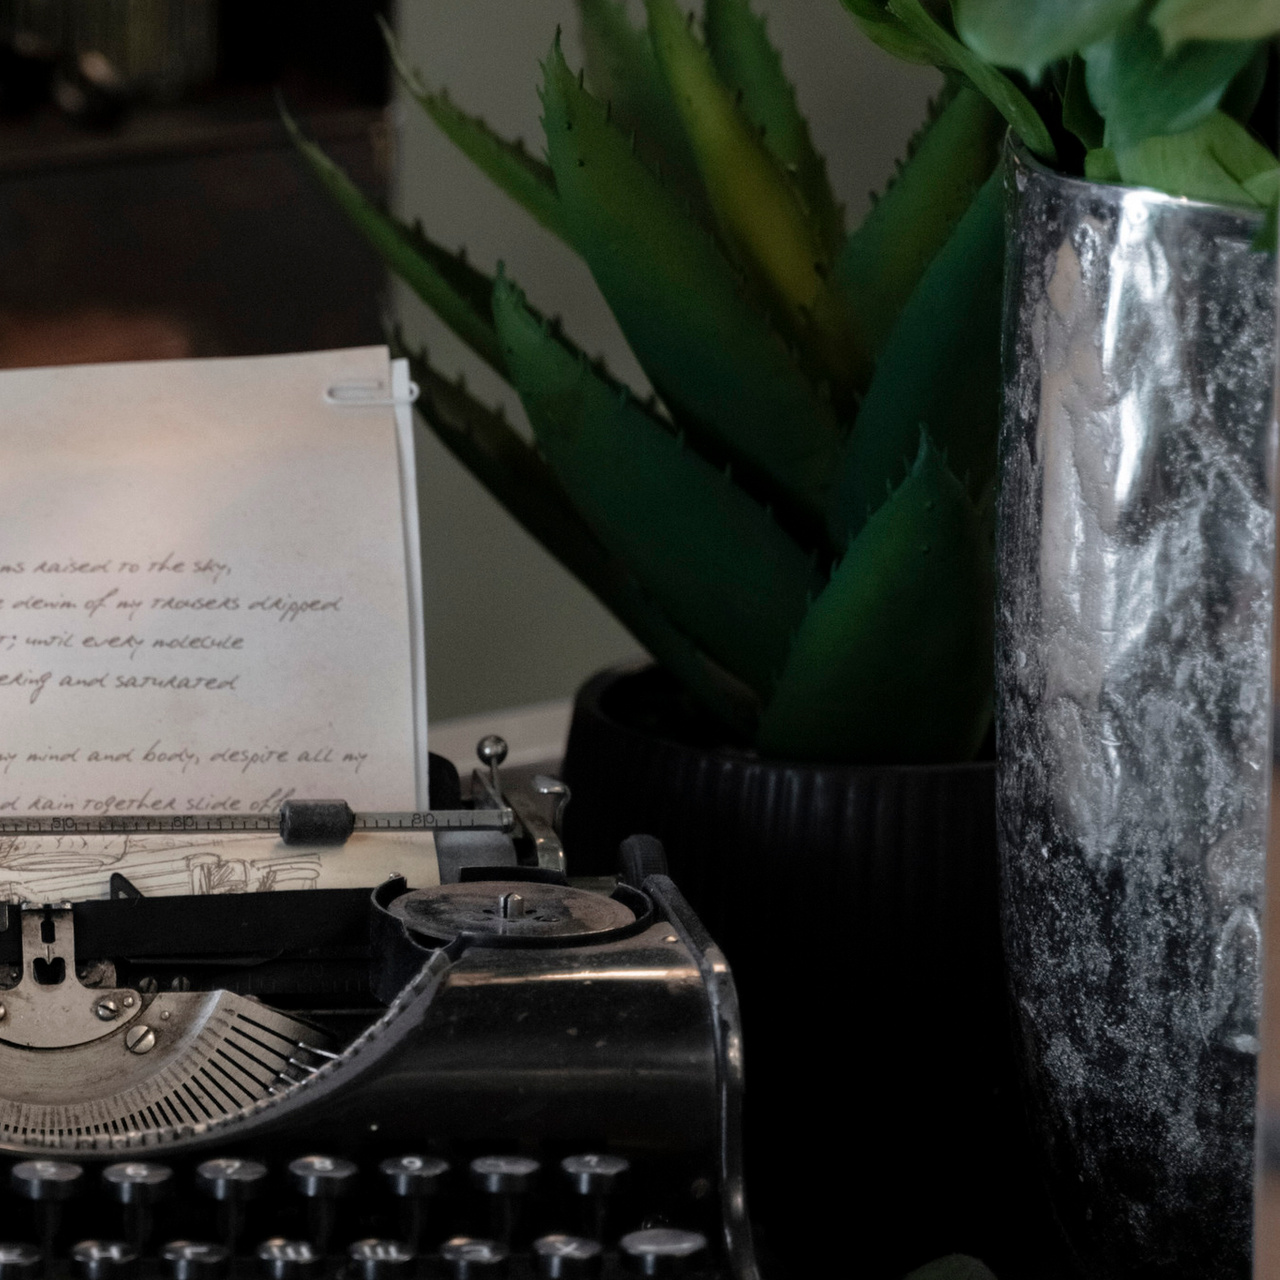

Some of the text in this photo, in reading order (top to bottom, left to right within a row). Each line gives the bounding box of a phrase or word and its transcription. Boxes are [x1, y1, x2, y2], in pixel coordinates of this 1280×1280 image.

[33, 559, 112, 574] raised
[118, 561, 140, 574] to
[147, 552, 185, 573] the
[193, 558, 232, 584] sky,
[11, 595, 77, 610] denim
[82, 587, 117, 619] of
[116, 599, 143, 622] my
[150, 596, 241, 611] trousers
[247, 596, 343, 623] dripped
[25, 633, 74, 648] until
[81, 634, 145, 661] every
[151, 634, 245, 650] molecule
[58, 672, 110, 688] and
[114, 674, 240, 691] saturated
[25, 747, 81, 763] mind
[86, 748, 135, 763] and
[141, 739, 200, 774] body,
[209, 748, 289, 774] despite
[296, 748, 334, 763] all
[341, 752, 368, 774] my
[27, 795, 75, 811] rain
[186, 796, 241, 811] slide
